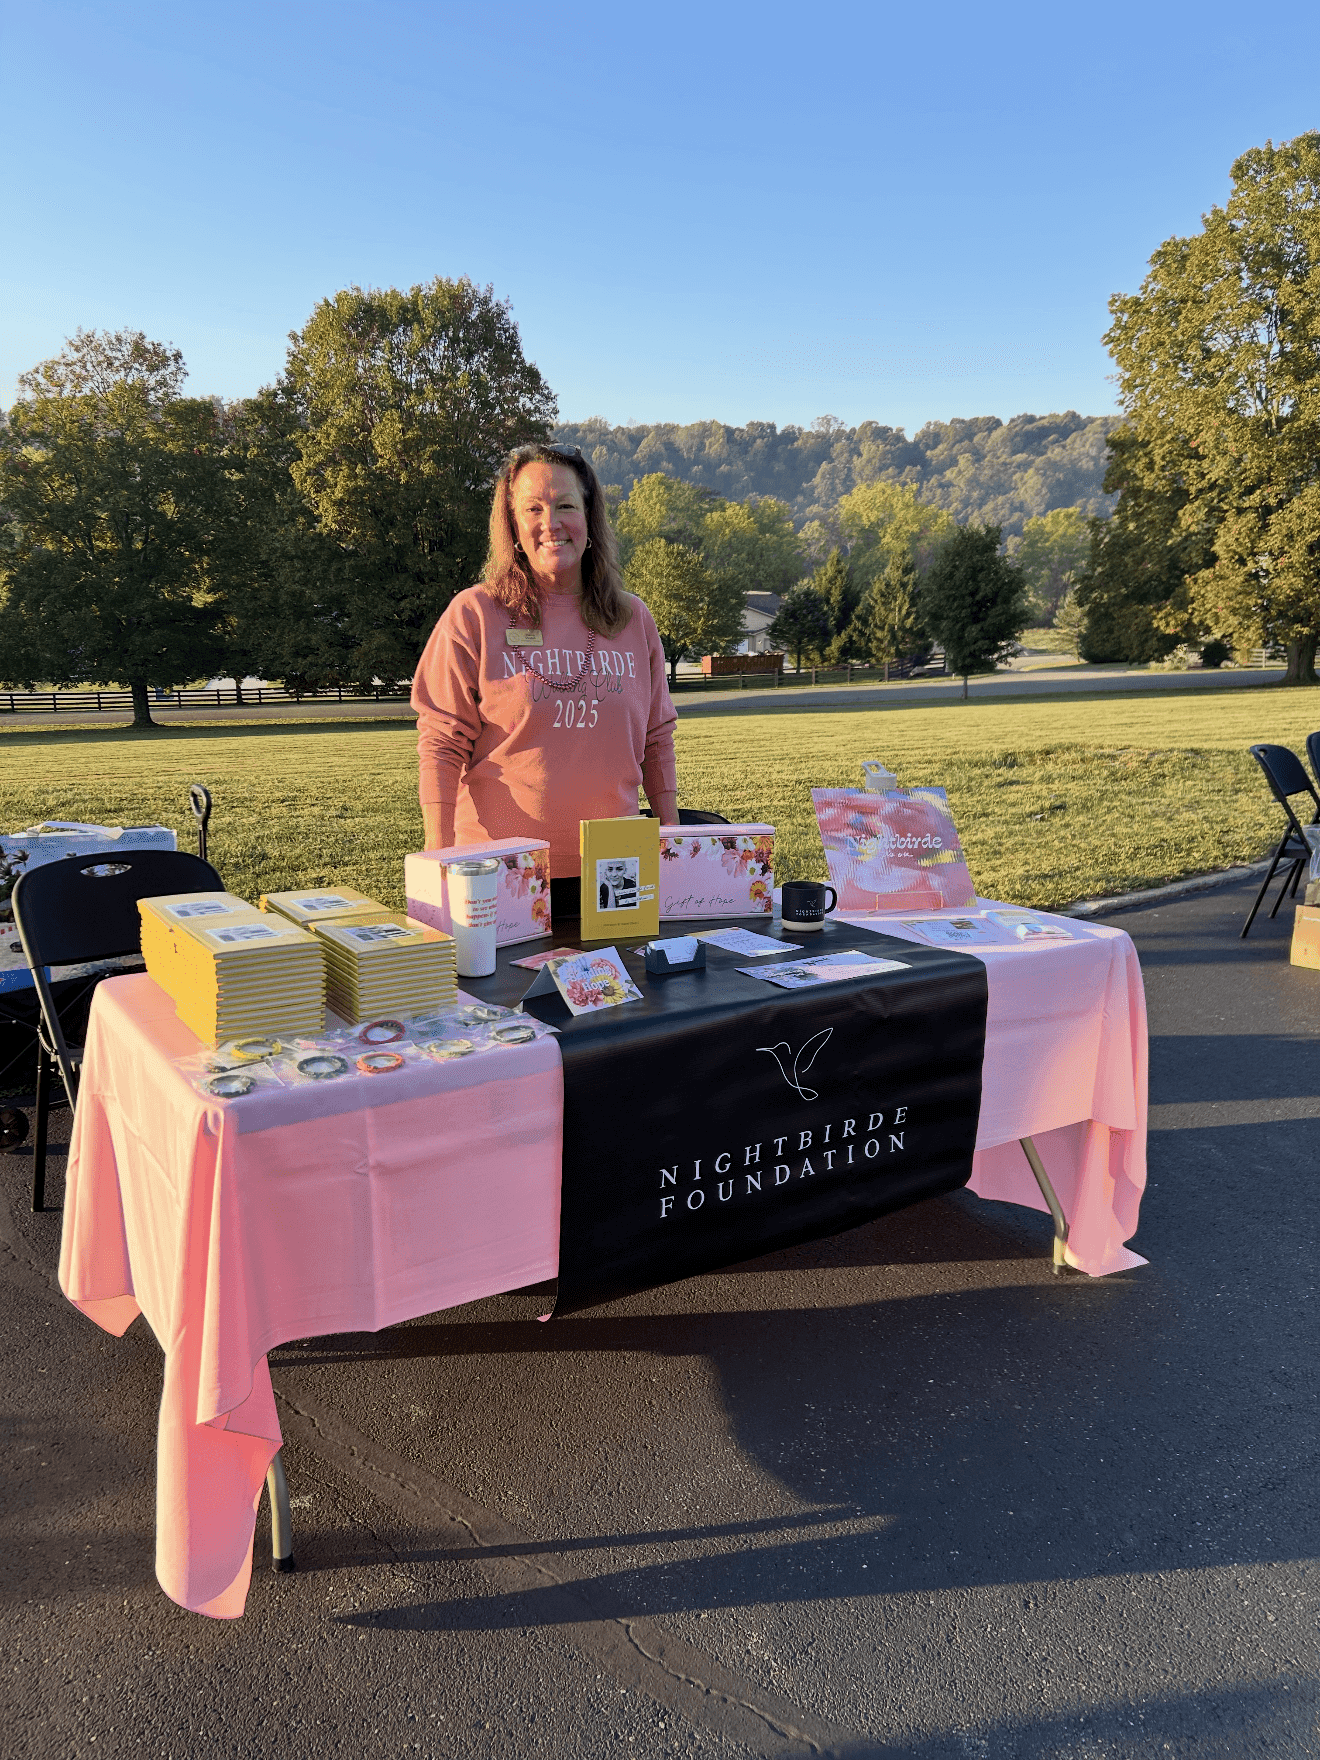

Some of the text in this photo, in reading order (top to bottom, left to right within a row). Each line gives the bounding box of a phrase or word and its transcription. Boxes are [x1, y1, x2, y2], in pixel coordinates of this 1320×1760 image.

[553, 699, 599, 728] 2025
[845, 833, 942, 854] Nightbirde
[665, 894, 694, 913] Gift
[695, 897, 705, 907] of
[708, 893, 736, 907] Hope
[582, 979, 611, 992] Hope
[659, 1107, 908, 1189] NIGHTBIRDE
[659, 1132, 905, 1219] FOUNDATION
